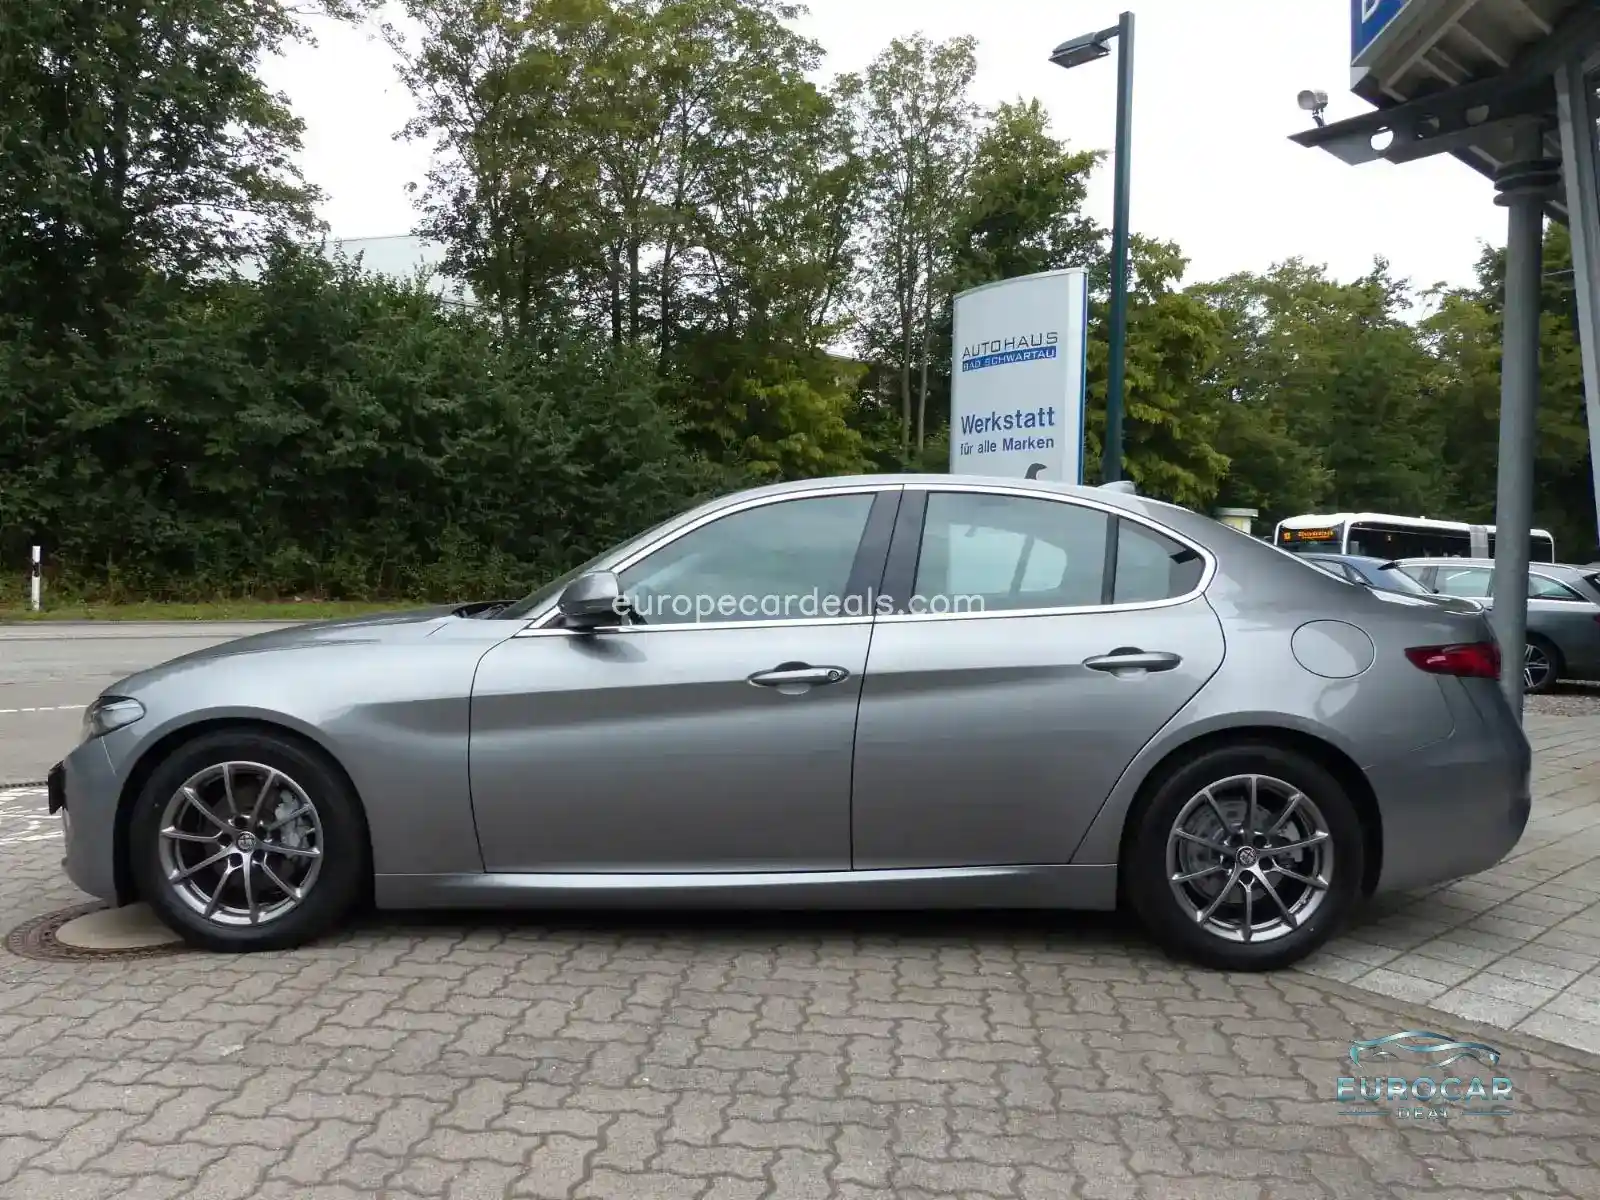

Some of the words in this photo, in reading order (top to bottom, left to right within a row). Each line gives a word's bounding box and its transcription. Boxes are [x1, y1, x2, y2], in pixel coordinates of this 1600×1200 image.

[962, 332, 1058, 359] AUTOHAUS
[963, 360, 981, 371] BAD
[985, 349, 1055, 365] SCHWARTAU
[961, 406, 1055, 435] Werkstatt
[960, 442, 973, 456] für
[977, 439, 997, 454] alle
[1002, 435, 1054, 452] Marken
